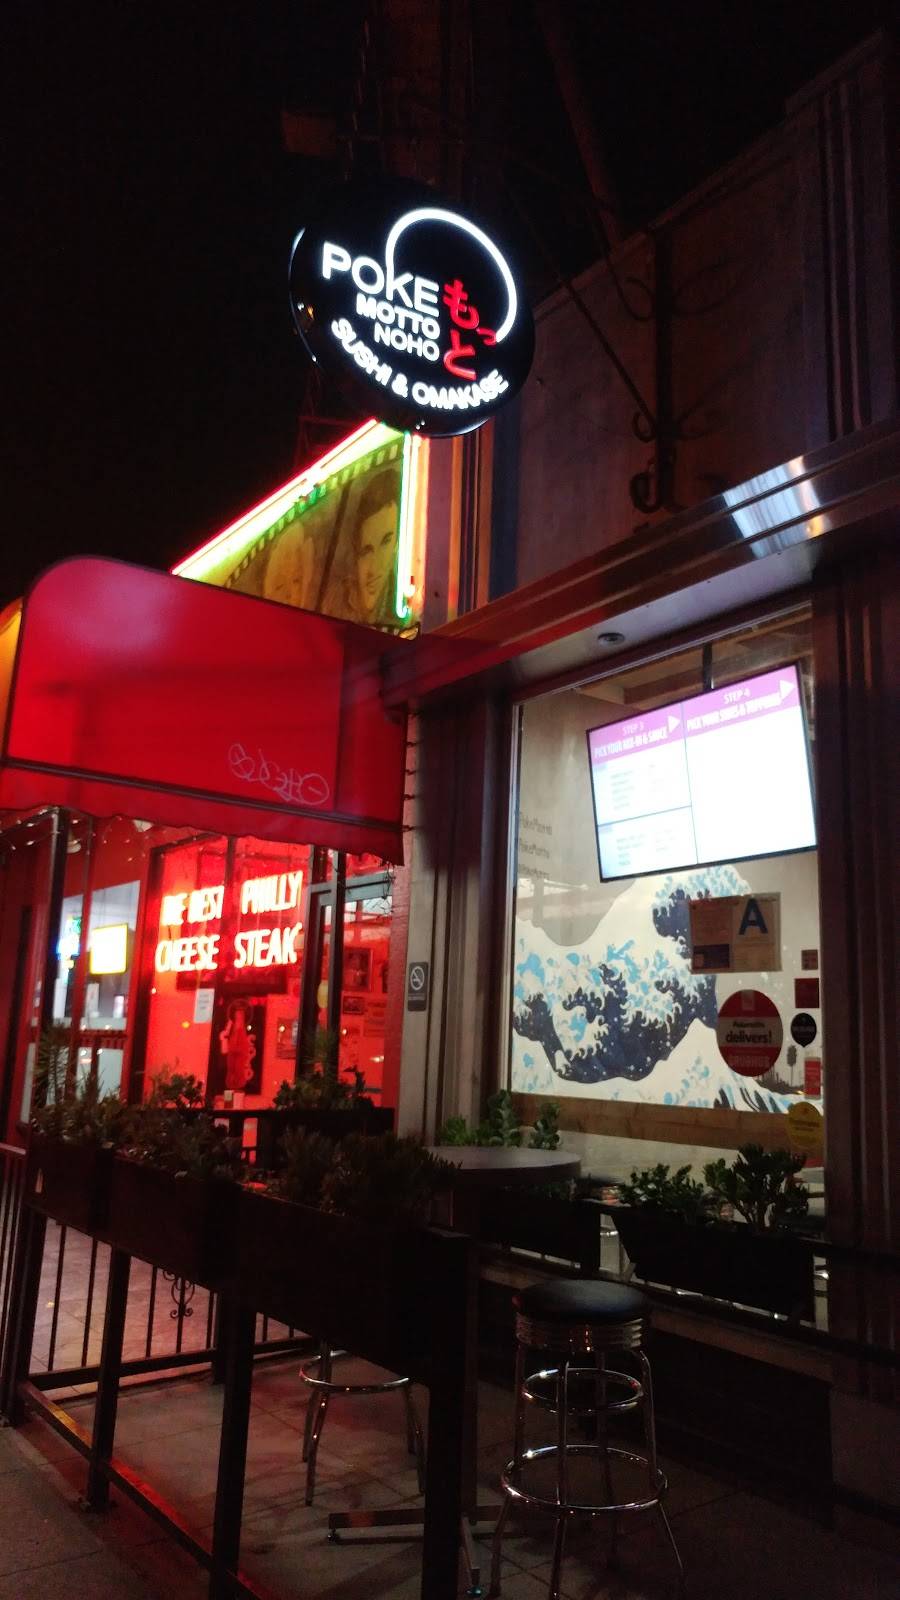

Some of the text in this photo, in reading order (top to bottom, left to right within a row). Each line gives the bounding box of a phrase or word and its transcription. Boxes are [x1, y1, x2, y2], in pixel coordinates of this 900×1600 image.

[322, 241, 440, 317] POKE
[356, 293, 440, 339] MOTTO
[331, 318, 509, 409] SUSHI & OMAKASE
[374, 324, 440, 361] NOHO
[187, 885, 225, 924] BEST
[241, 869, 303, 915] PHILLY
[738, 898, 768, 935] A
[155, 922, 303, 973] CHEESE STEAK
[725, 1030, 772, 1043] delivers!
